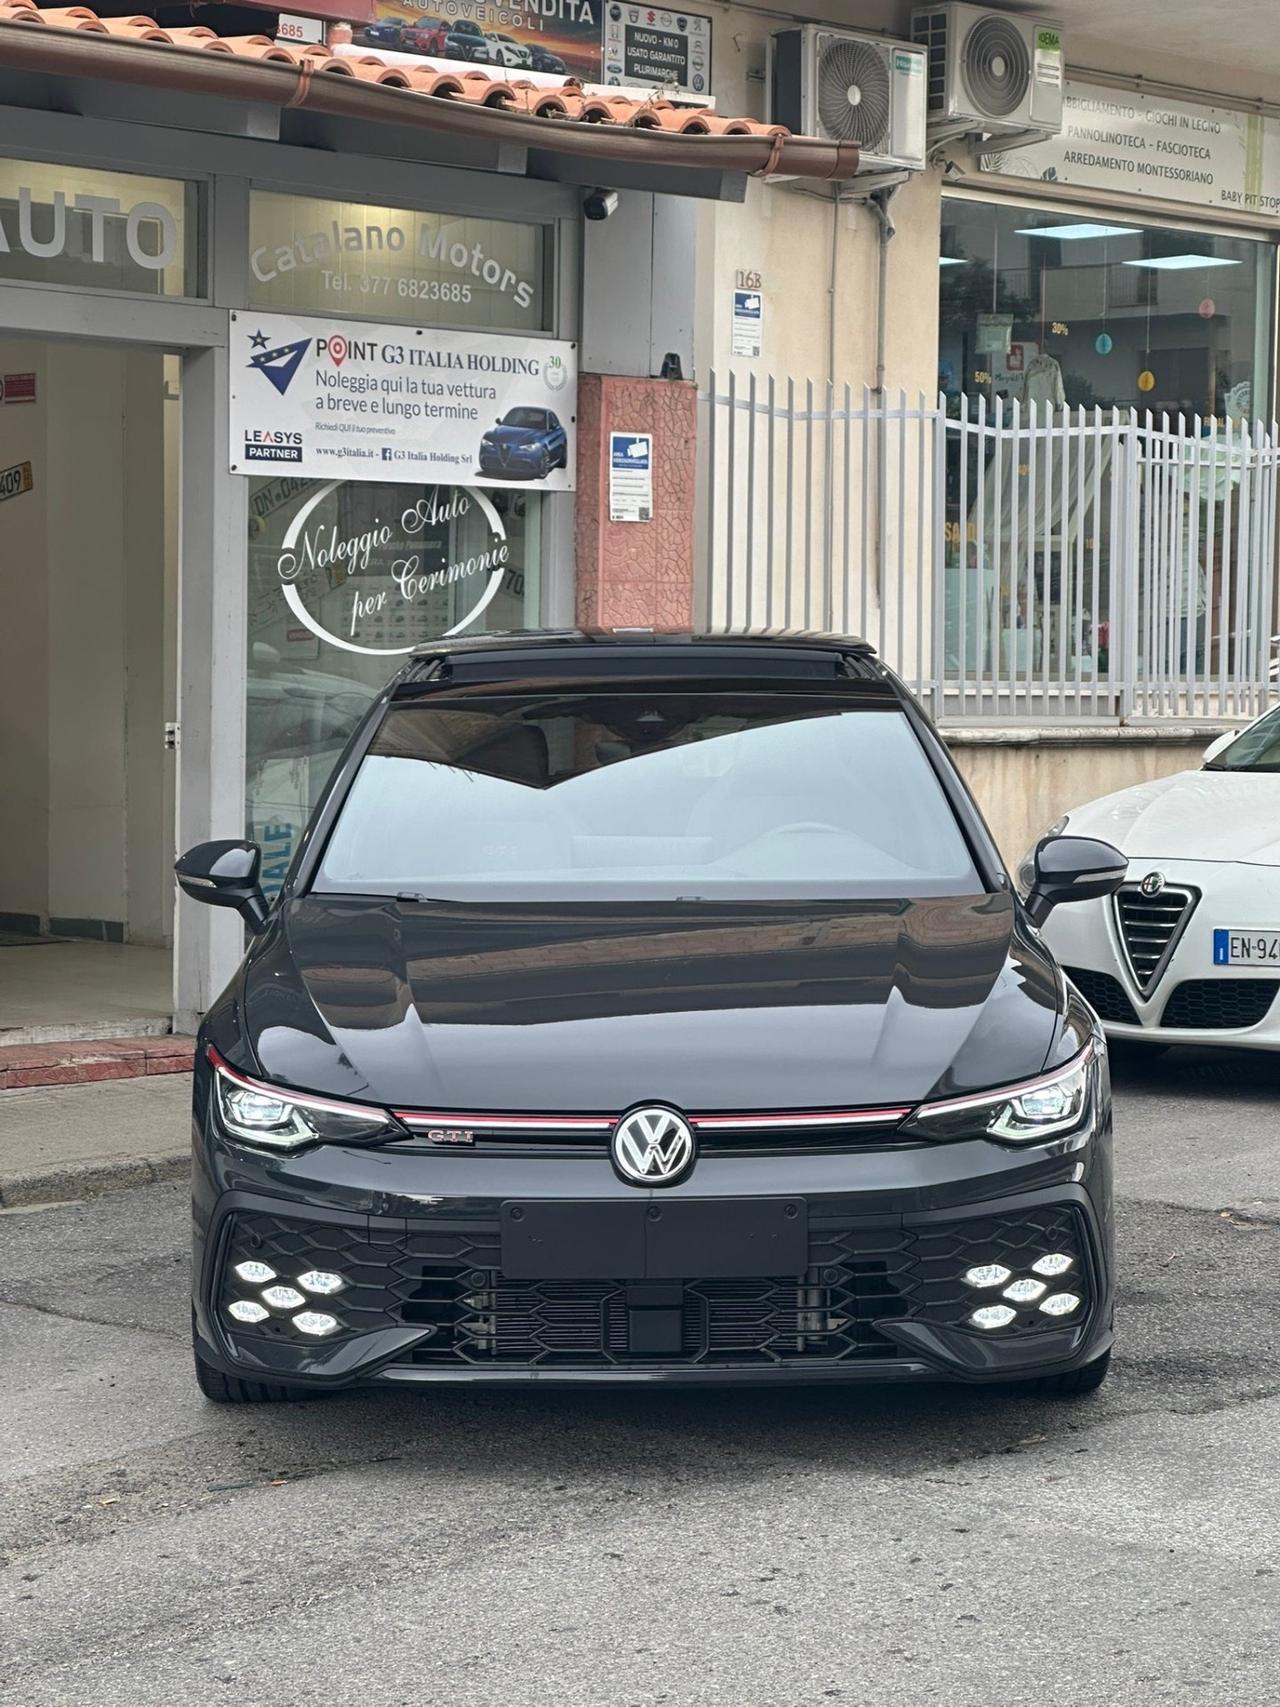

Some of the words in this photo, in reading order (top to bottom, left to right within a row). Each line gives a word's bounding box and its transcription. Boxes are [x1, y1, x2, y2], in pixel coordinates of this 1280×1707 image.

[634, 31, 657, 45] NUOVO
[663, 36, 673, 47] KM
[627, 47, 648, 58] USATO
[649, 50, 686, 65] GARANTITO
[633, 63, 679, 80] PLURIMARCHE
[1145, 110, 1177, 128] GIOCHI
[1180, 116, 1189, 128] IN
[1191, 117, 1221, 135] LEGNO
[1067, 125, 1146, 149] PANNOLINOTECA
[1156, 140, 1211, 160] FASCIOTECA
[1063, 150, 1134, 173] ARREDAMENTO
[1136, 162, 1214, 185] MONTESSORIANO
[1221, 189, 1243, 205] BABY
[1245, 193, 1258, 206] PIT
[250, 220, 406, 283] Catalano
[420, 222, 534, 309] Motors
[321, 268, 352, 292] Tel.
[359, 275, 390, 295] 377
[397, 277, 472, 304] 6823685
[739, 271, 762, 289] 16B
[316, 334, 378, 367] POINT
[381, 344, 405, 365] G3
[409, 348, 464, 370] ITALIA
[466, 352, 540, 376] HOLDING
[549, 355, 561, 369] 30
[315, 369, 378, 394] Noleggia
[381, 376, 402, 395] qui
[406, 376, 418, 394] la
[421, 379, 444, 396] tua
[446, 381, 497, 400] vettura
[315, 395, 324, 410] a
[327, 392, 368, 413] breve
[370, 400, 379, 414] e
[382, 397, 421, 419] lungo
[424, 401, 479, 420] termine
[244, 429, 303, 445] LEASYS
[249, 447, 298, 459] PARTNER
[315, 446, 374, 459] www.g3italia.it
[394, 449, 406, 460] G3
[407, 451, 428, 462] Italia
[429, 452, 460, 464] Holding
[461, 453, 473, 464] Srl
[277, 518, 393, 580] Noleggio
[401, 484, 471, 534] Auto
[350, 591, 387, 637] per
[391, 537, 510, 600] Cerimonie
[1230, 936, 1280, 960] EN-94
[427, 1129, 474, 1143] GTI
